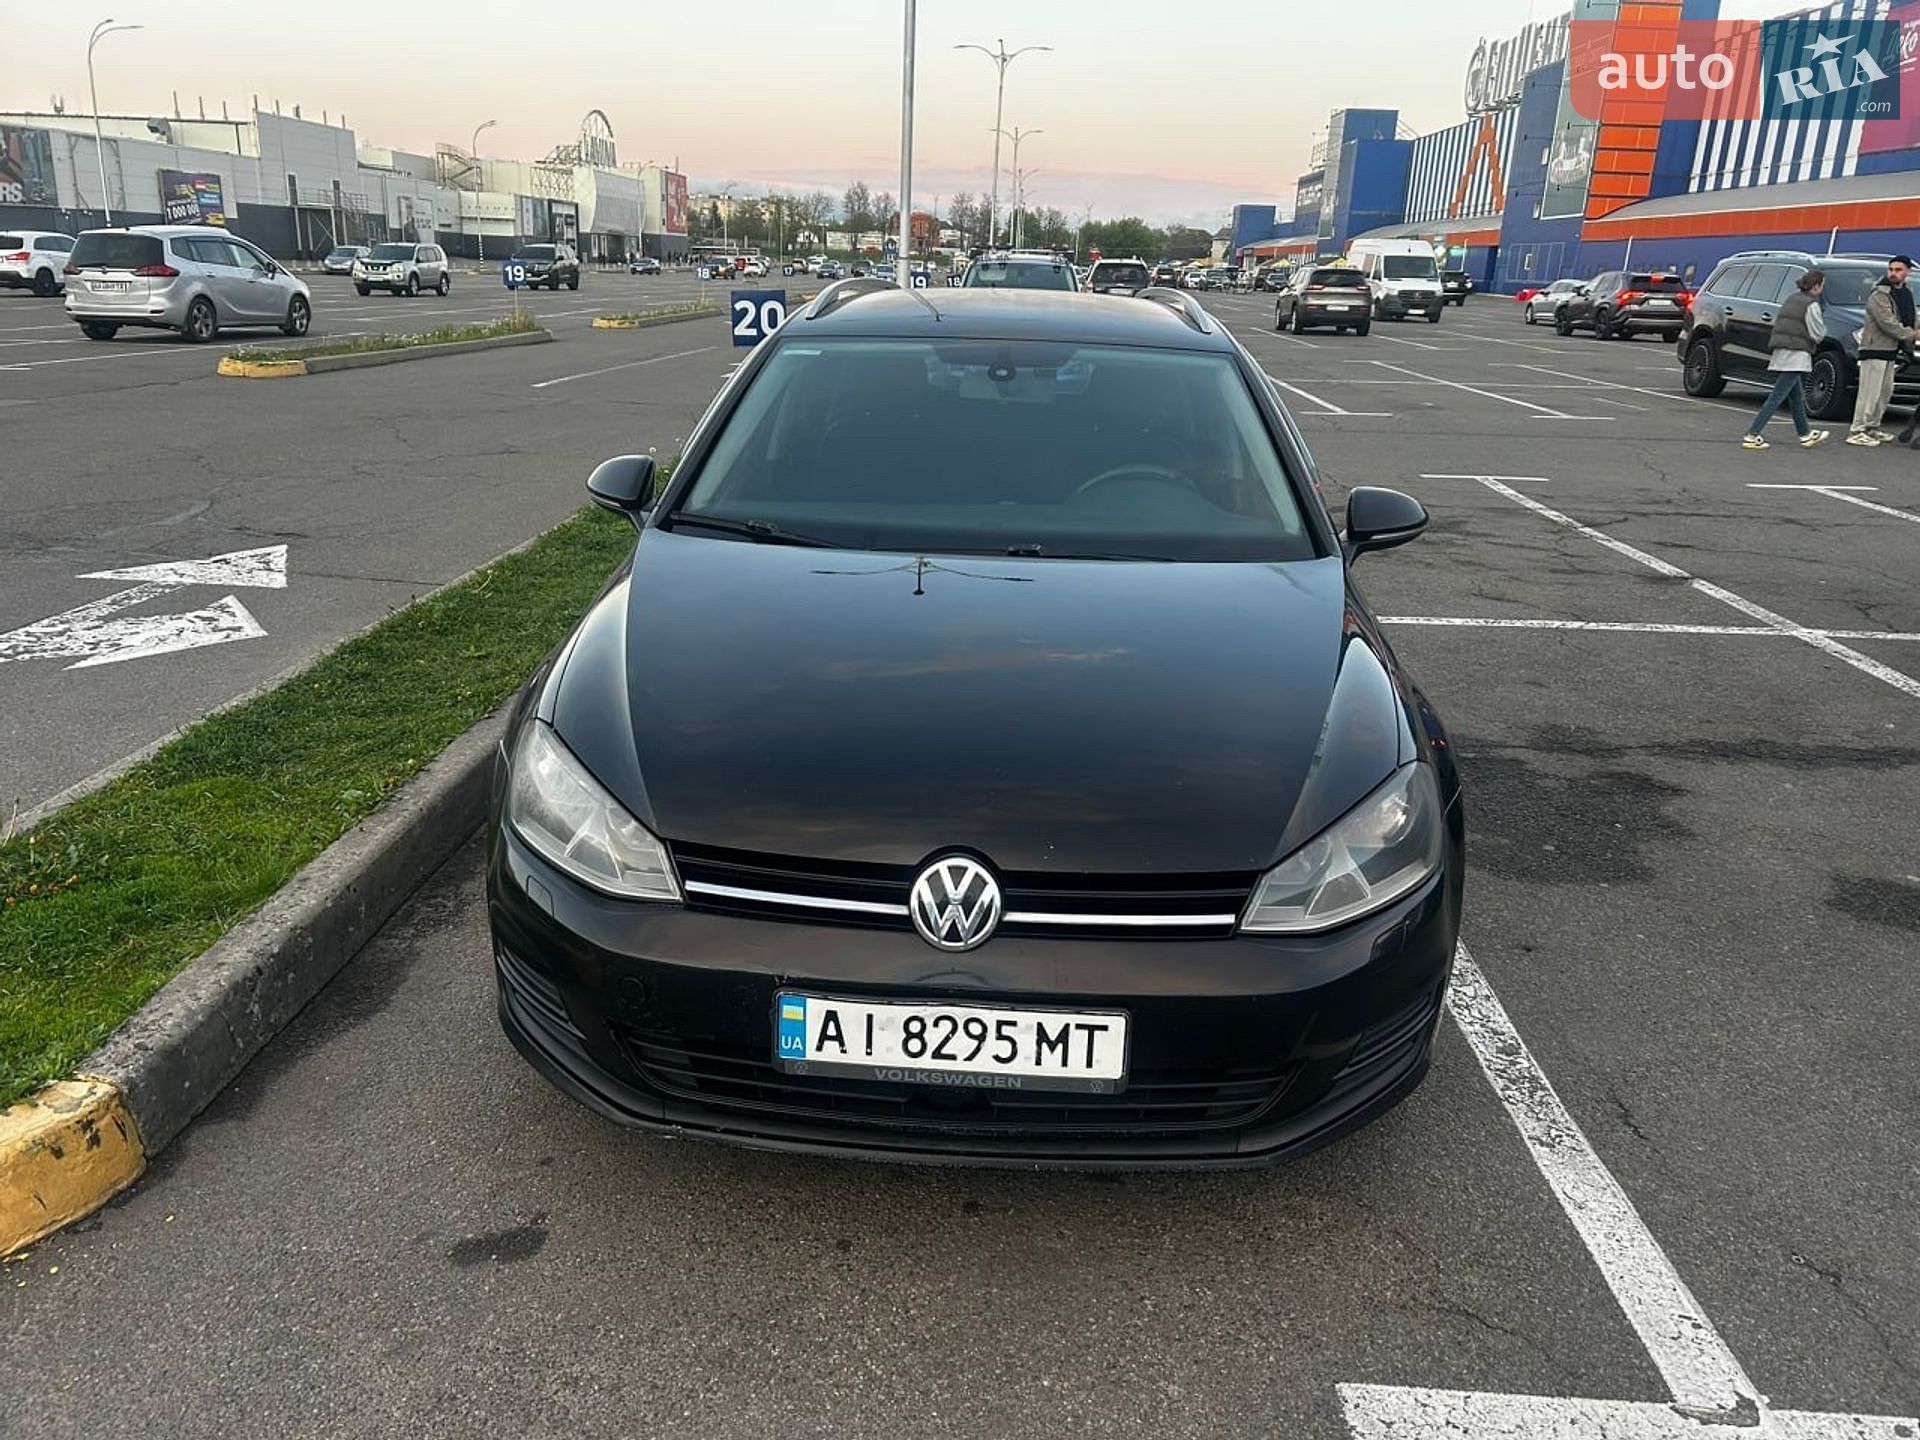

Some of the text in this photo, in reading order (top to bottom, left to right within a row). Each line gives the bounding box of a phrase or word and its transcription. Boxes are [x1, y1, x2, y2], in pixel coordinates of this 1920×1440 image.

[504, 265, 525, 282] 19
[733, 299, 785, 336] 20
[781, 1035, 803, 1051] UA
[901, 1014, 1019, 1065] 8295
[1034, 1021, 1109, 1069] MT
[874, 1067, 1022, 1089] VOLKSWAGEN
